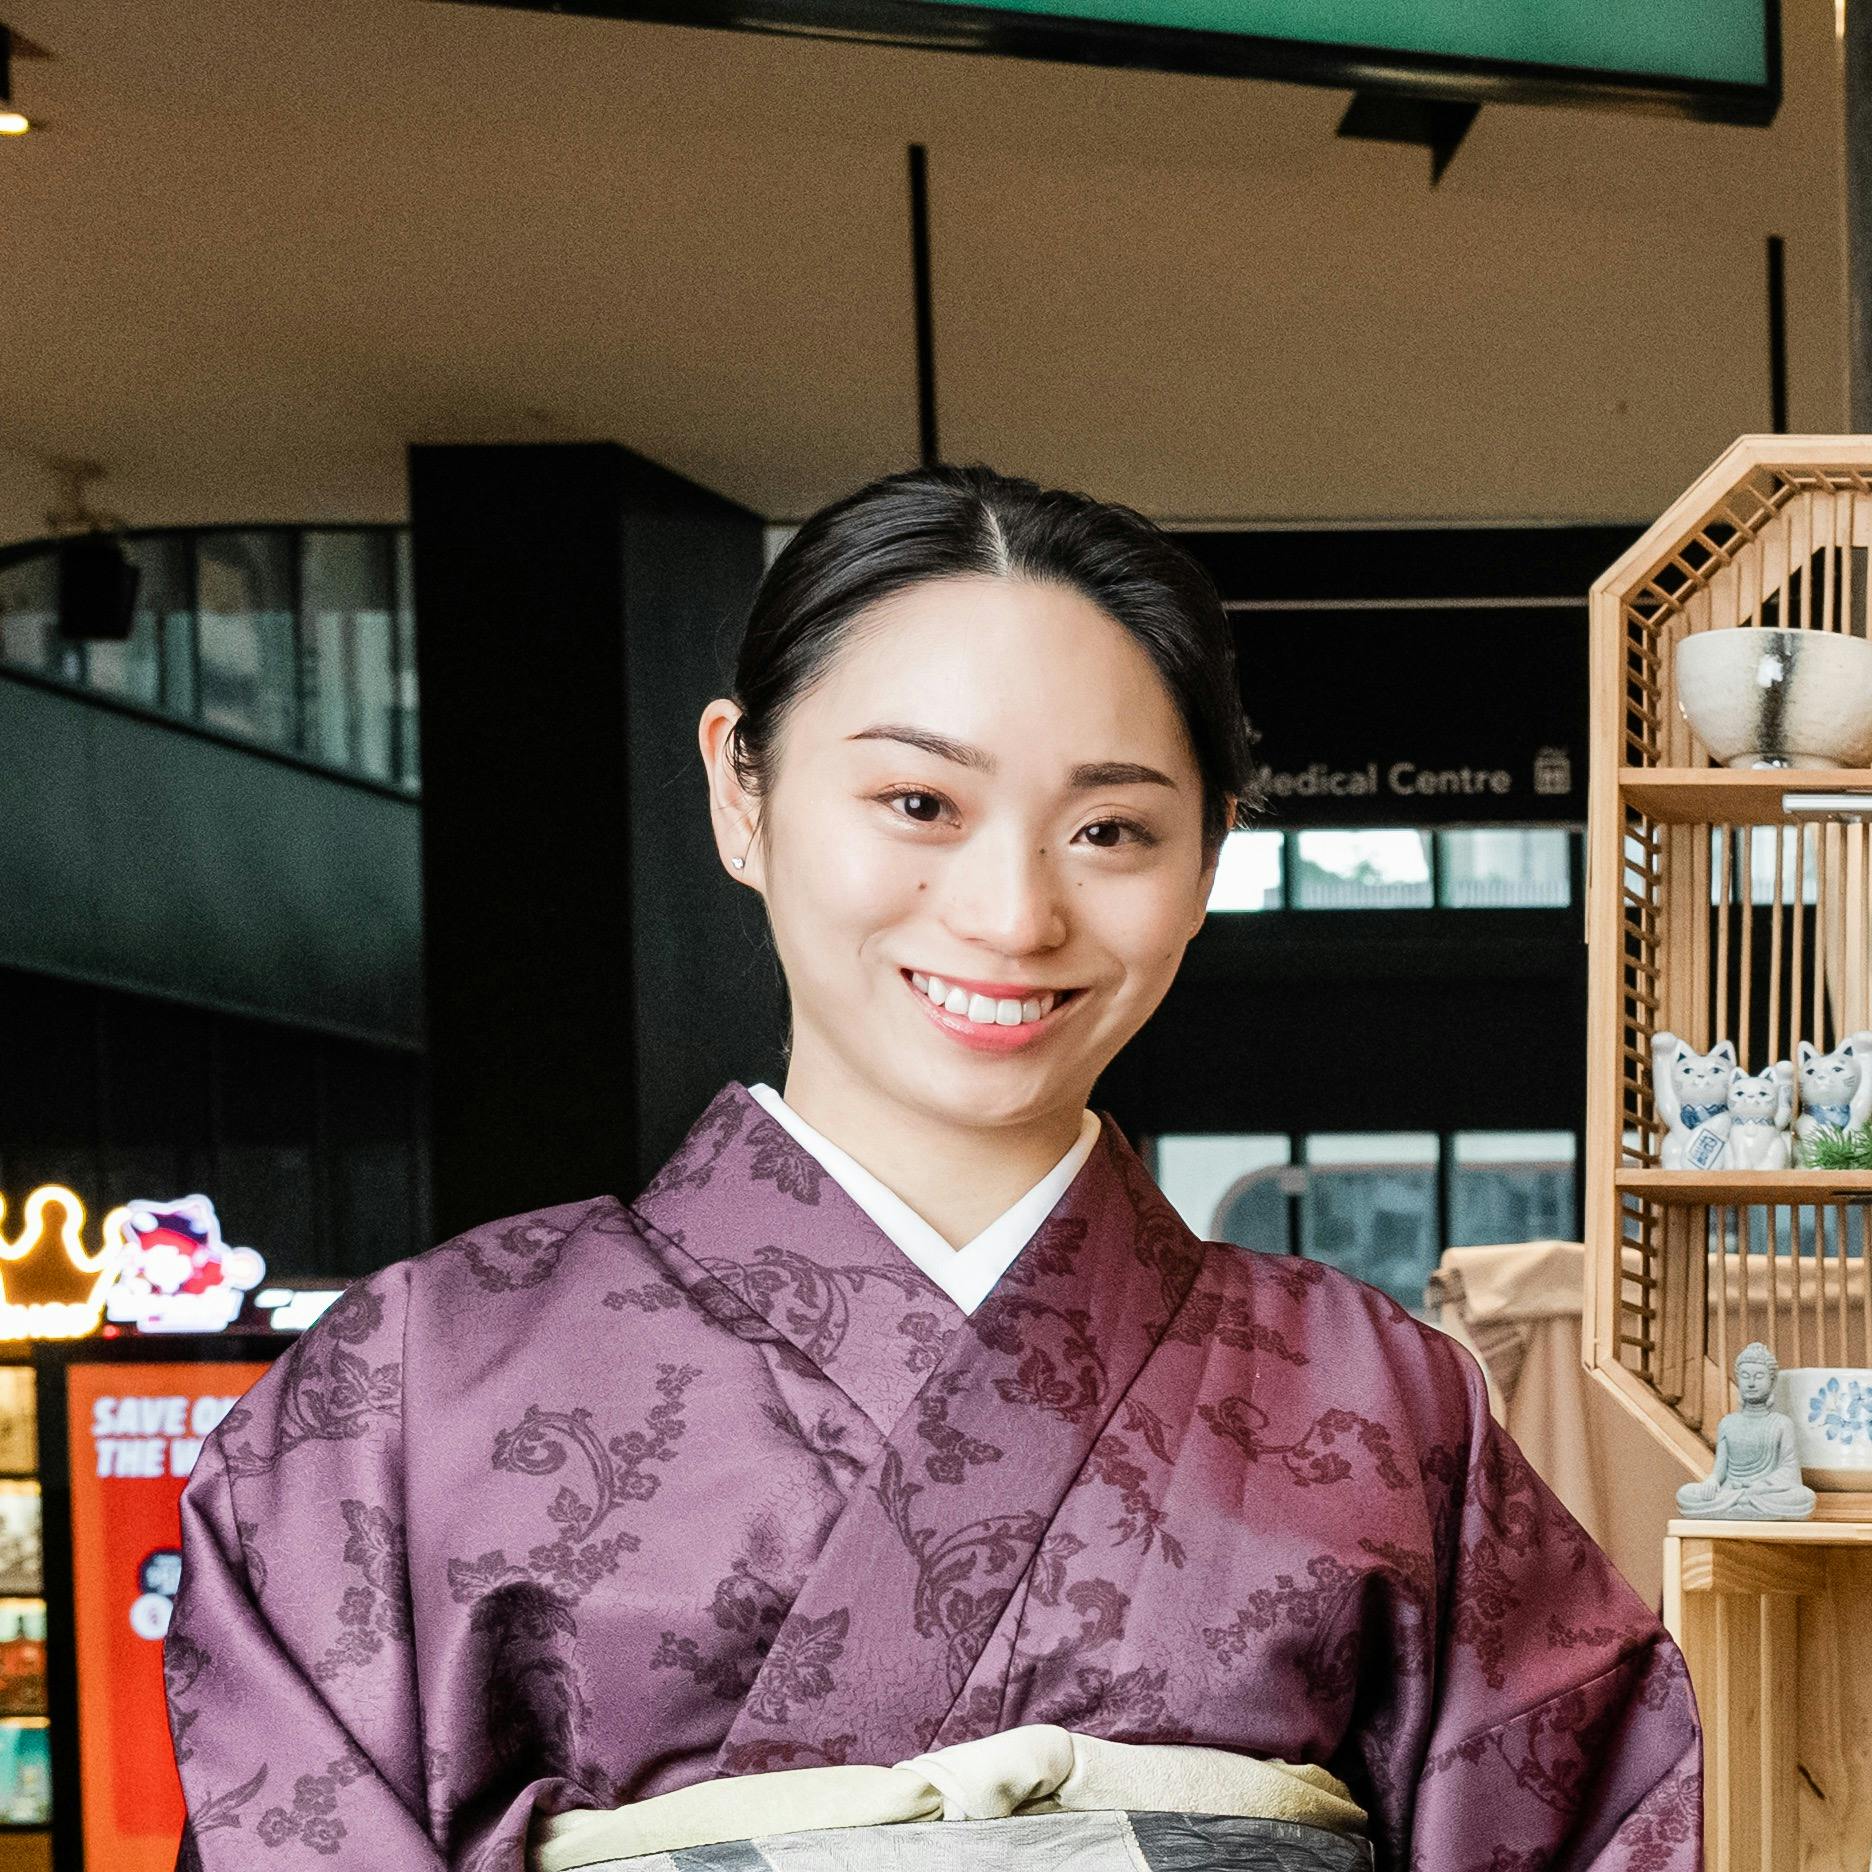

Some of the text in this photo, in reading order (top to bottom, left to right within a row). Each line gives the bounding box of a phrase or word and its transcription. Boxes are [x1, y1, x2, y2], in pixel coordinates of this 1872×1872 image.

[1388, 763, 1512, 796] Centre
[92, 1397, 188, 1436] SAVE
[97, 1440, 164, 1478] THE
